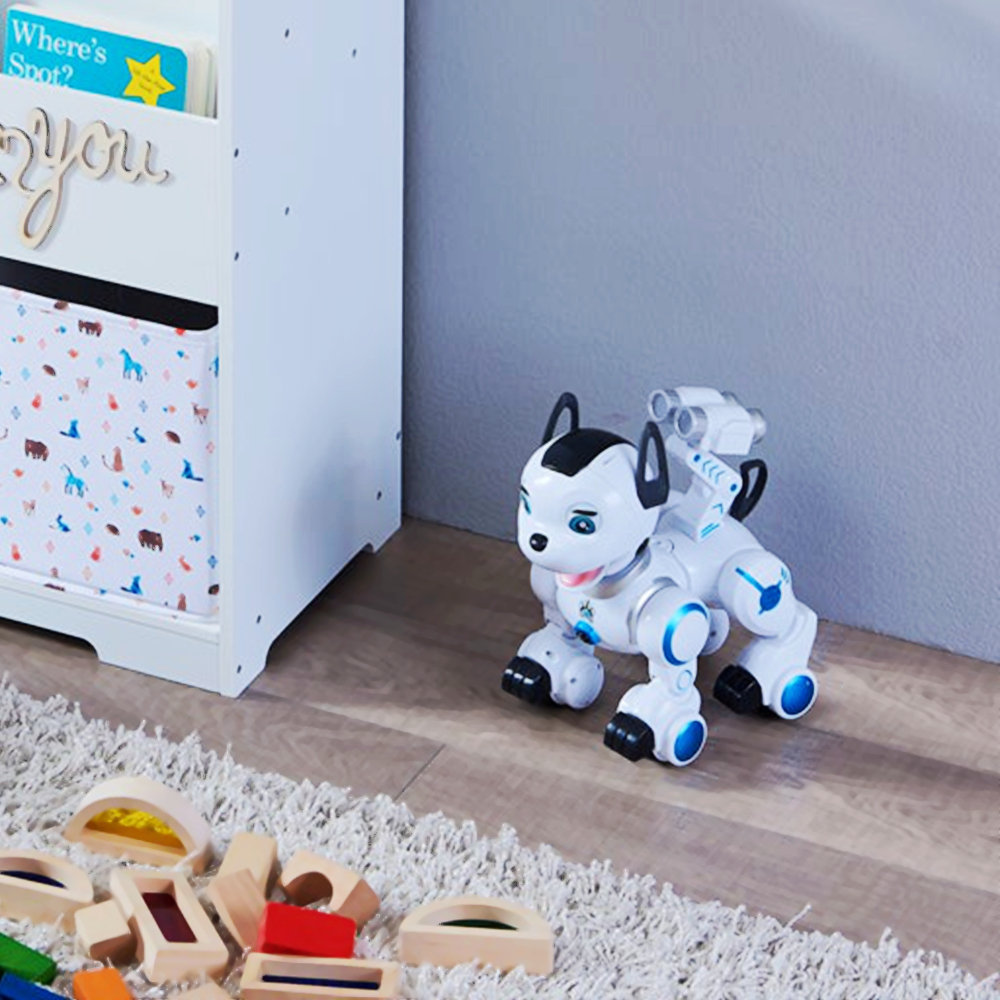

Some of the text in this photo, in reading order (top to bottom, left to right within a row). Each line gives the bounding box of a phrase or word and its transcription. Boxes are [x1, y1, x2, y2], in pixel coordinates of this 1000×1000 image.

[12, 18, 107, 65] Where's
[9, 51, 74, 88] Spot?
[17, 106, 169, 250] you
